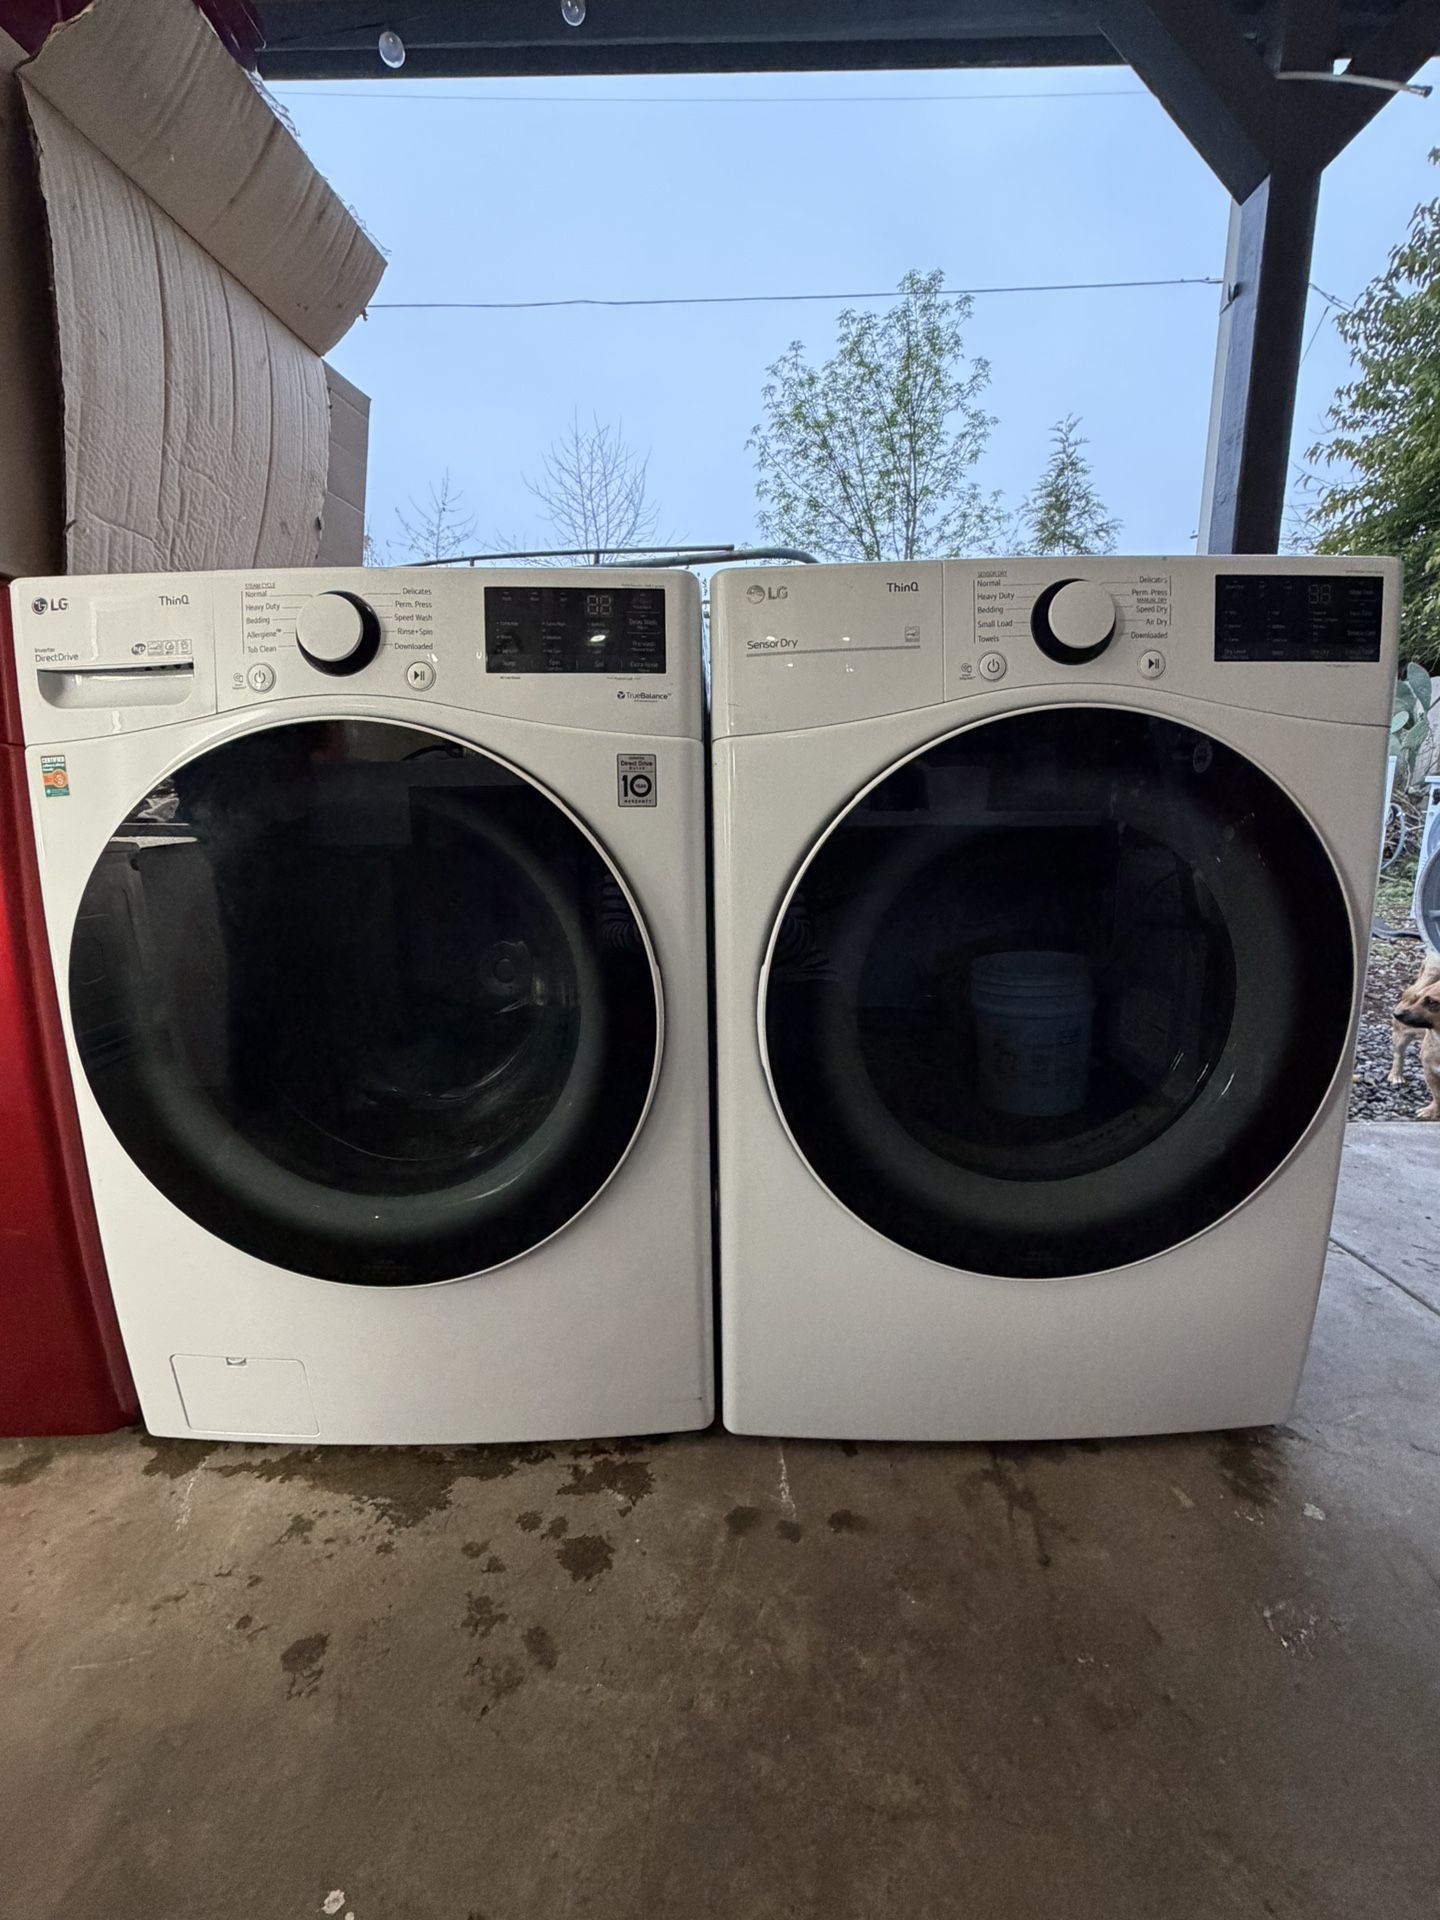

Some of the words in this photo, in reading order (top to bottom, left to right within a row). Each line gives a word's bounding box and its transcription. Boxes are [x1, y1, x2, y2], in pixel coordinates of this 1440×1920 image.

[886, 581, 919, 592] ThinQ
[977, 579, 1001, 587] Normal
[402, 587, 432, 595] Delicates
[767, 586, 788, 600] LG
[1150, 589, 1168, 597] Press
[158, 594, 190, 606] ThinQ
[977, 593, 998, 601] Heavy
[998, 592, 1015, 600] Duty
[50, 598, 69, 611] LG
[245, 603, 264, 612] Heavy
[265, 602, 281, 611] Duty
[395, 601, 413, 609] Perm.
[414, 601, 433, 609] Press
[977, 605, 1004, 615] Bedding
[1135, 606, 1154, 614] Speed
[1155, 606, 1168, 615] Dry
[246, 616, 271, 626] Bedding
[393, 613, 414, 622] Speed
[415, 613, 433, 621] Wash
[977, 620, 996, 628] Small
[996, 619, 1013, 627] Load
[1155, 618, 1168, 628] Dry
[977, 634, 1000, 643] Towels
[1130, 631, 1168, 640] Downloaded
[394, 642, 434, 651] Downloaded
[746, 640, 779, 650] Sensor
[780, 638, 798, 649] Dry
[247, 645, 259, 653] Tub
[259, 645, 277, 653] Clean
[621, 774, 653, 798] 10
